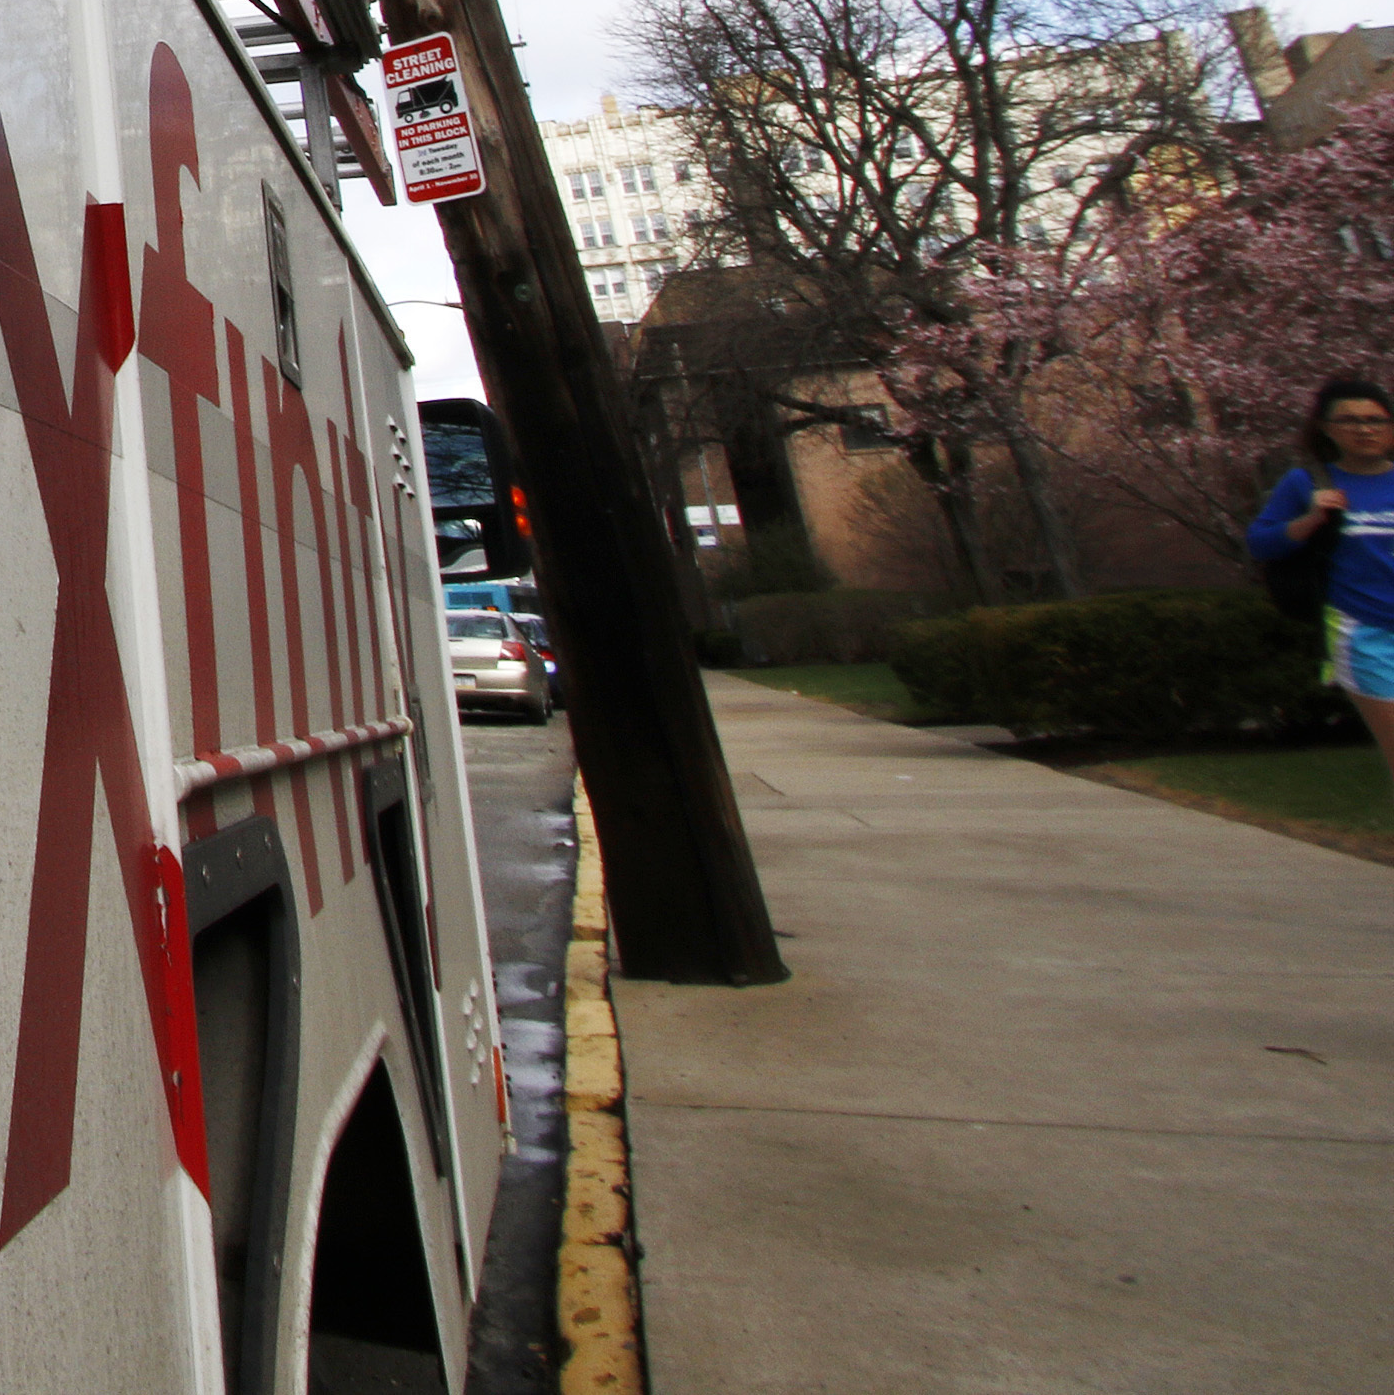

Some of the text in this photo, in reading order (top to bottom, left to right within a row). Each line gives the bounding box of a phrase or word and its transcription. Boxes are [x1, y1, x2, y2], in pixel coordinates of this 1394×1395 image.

[393, 47, 442, 71] STREET
[386, 58, 455, 85] CLEANING
[399, 125, 467, 149] IN THIS BLOCK
[401, 116, 461, 138] NO PARKING
[412, 151, 465, 168] of each month
[409, 184, 426, 193] April
[435, 176, 468, 186] November
